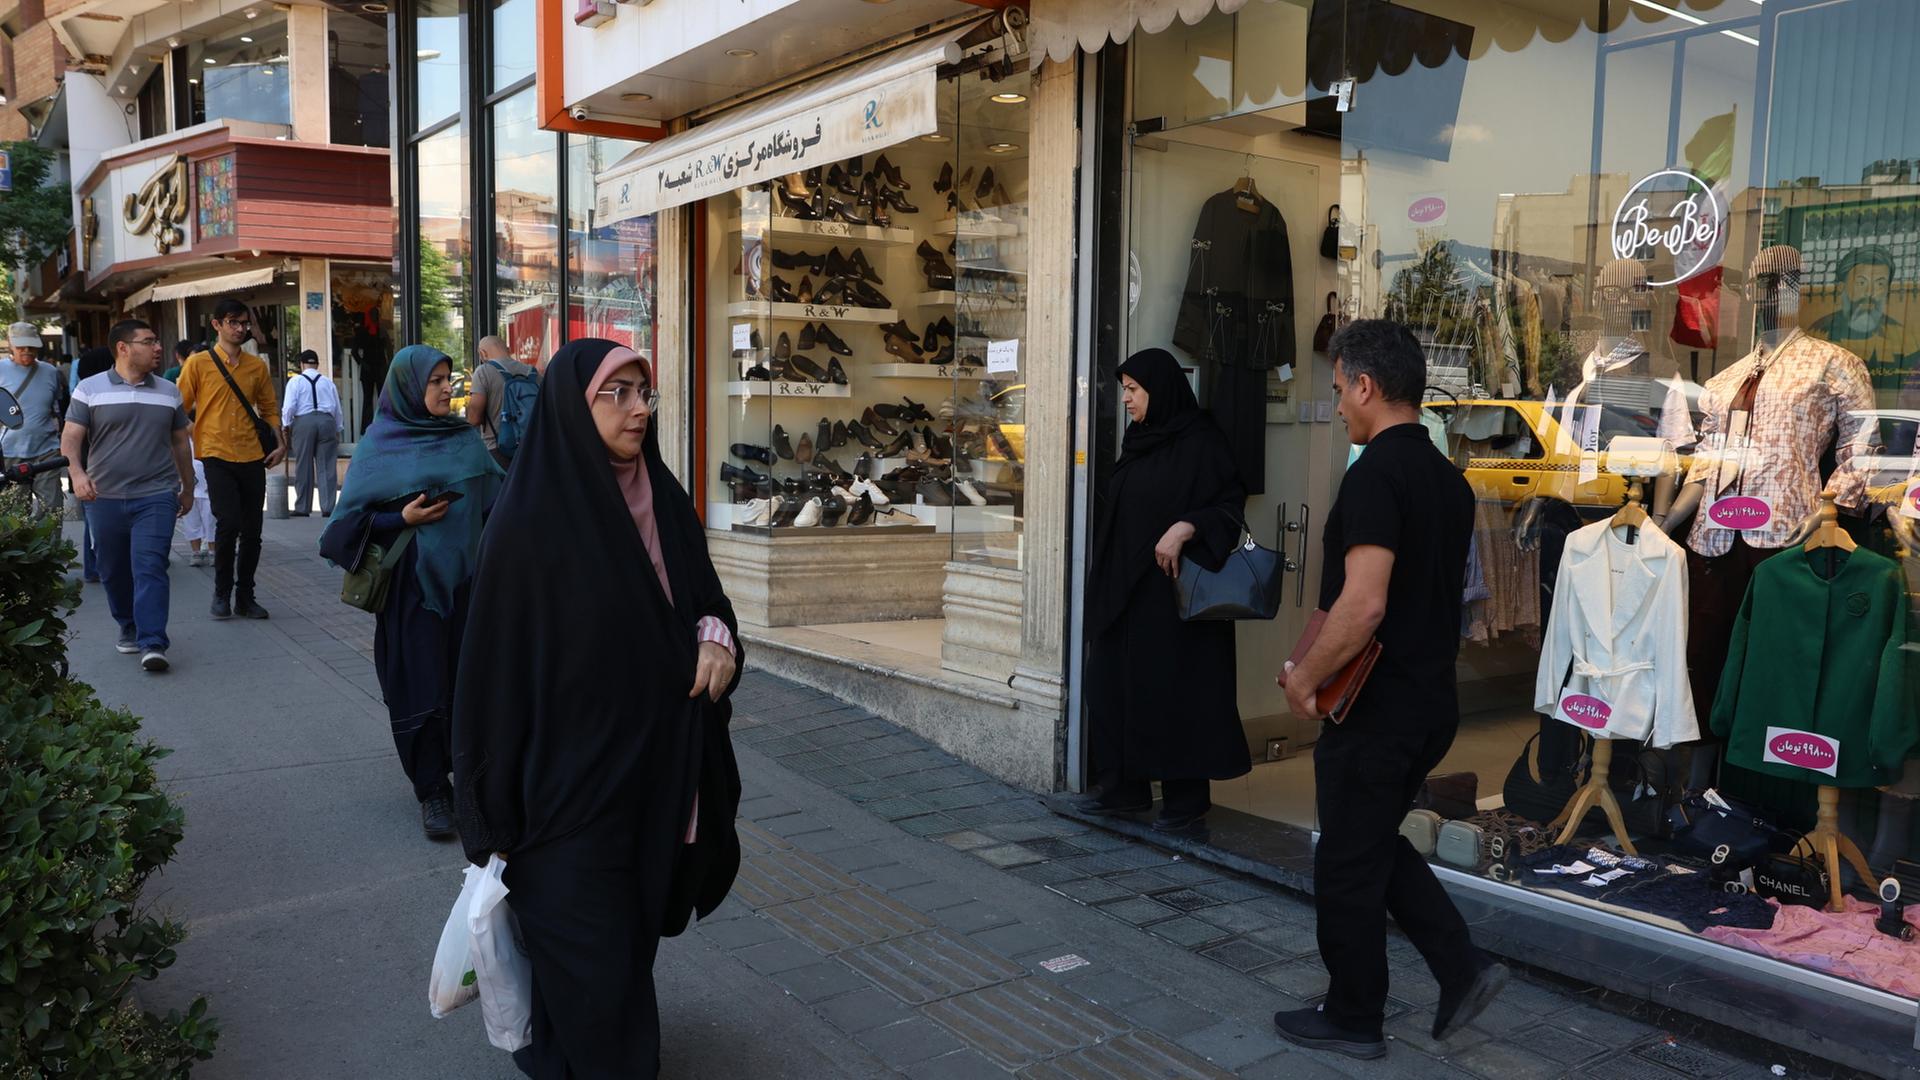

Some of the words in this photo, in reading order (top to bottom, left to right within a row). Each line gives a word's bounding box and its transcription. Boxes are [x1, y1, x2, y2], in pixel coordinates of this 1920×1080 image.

[767, 116, 823, 160] فروشگاه
[723, 140, 767, 180] مرکزی
[664, 162, 693, 192] شعبه
[1716, 507, 1735, 519] تومان
[1566, 701, 1588, 715] تومان
[1586, 704, 1610, 720] ۹۹۸۰۰۰
[1776, 740, 1803, 755] تومان
[1802, 742, 1832, 758] ۹۹۸۰۰۰
[1759, 874, 1812, 898] CHANEL
